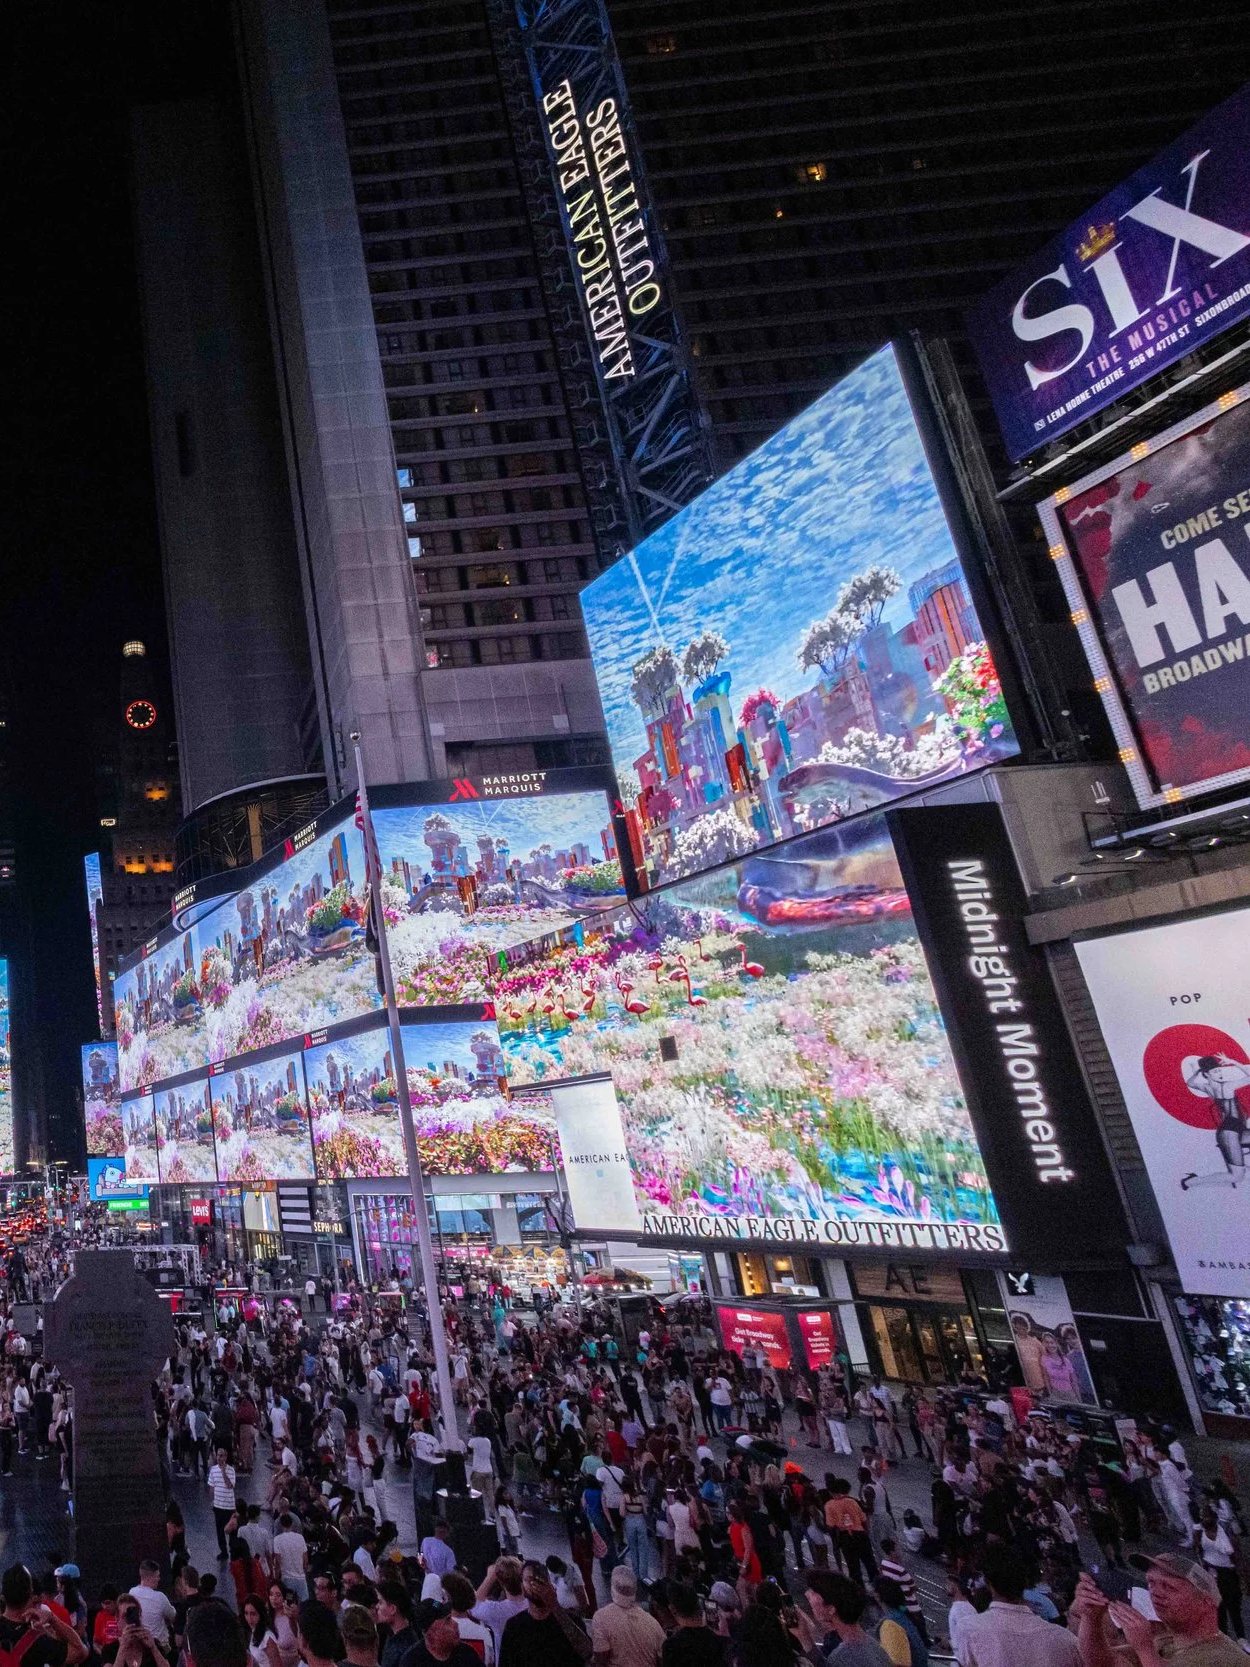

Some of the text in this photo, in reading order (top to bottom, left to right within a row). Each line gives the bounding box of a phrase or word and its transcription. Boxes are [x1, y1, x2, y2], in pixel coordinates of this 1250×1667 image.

[586, 98, 661, 316] OUTFITTERS
[543, 78, 636, 380] AMERICAN EAGLE
[1012, 149, 1250, 391] SIX
[1086, 283, 1218, 378] THE MUSICAL
[1046, 406, 1067, 424] LENA
[1065, 389, 1091, 412] HORNE
[1090, 366, 1126, 395] THEATRE
[1128, 353, 1146, 370] 256
[1145, 346, 1155, 359] W
[1156, 332, 1179, 352] 47TH
[1177, 323, 1190, 338] ST
[1160, 505, 1223, 550] COME
[1112, 523, 1250, 670] HA
[483, 772, 547, 785] MARRIOTT
[484, 783, 541, 796] MARQUIS
[293, 820, 317, 842] MARRIOTT
[294, 832, 316, 851] MARQUIS
[174, 884, 196, 903] MARRIOTT
[175, 894, 194, 911] MARQUIS
[1170, 993, 1203, 1006] POP
[948, 859, 1075, 1184] Midnight Moment
[569, 1154, 610, 1164] AMERICAN
[643, 1215, 1004, 1251] AMERICAN EAGLE OUTFITTERS
[885, 1263, 931, 1295] AE
[746, 1329, 774, 1340] Broadway
